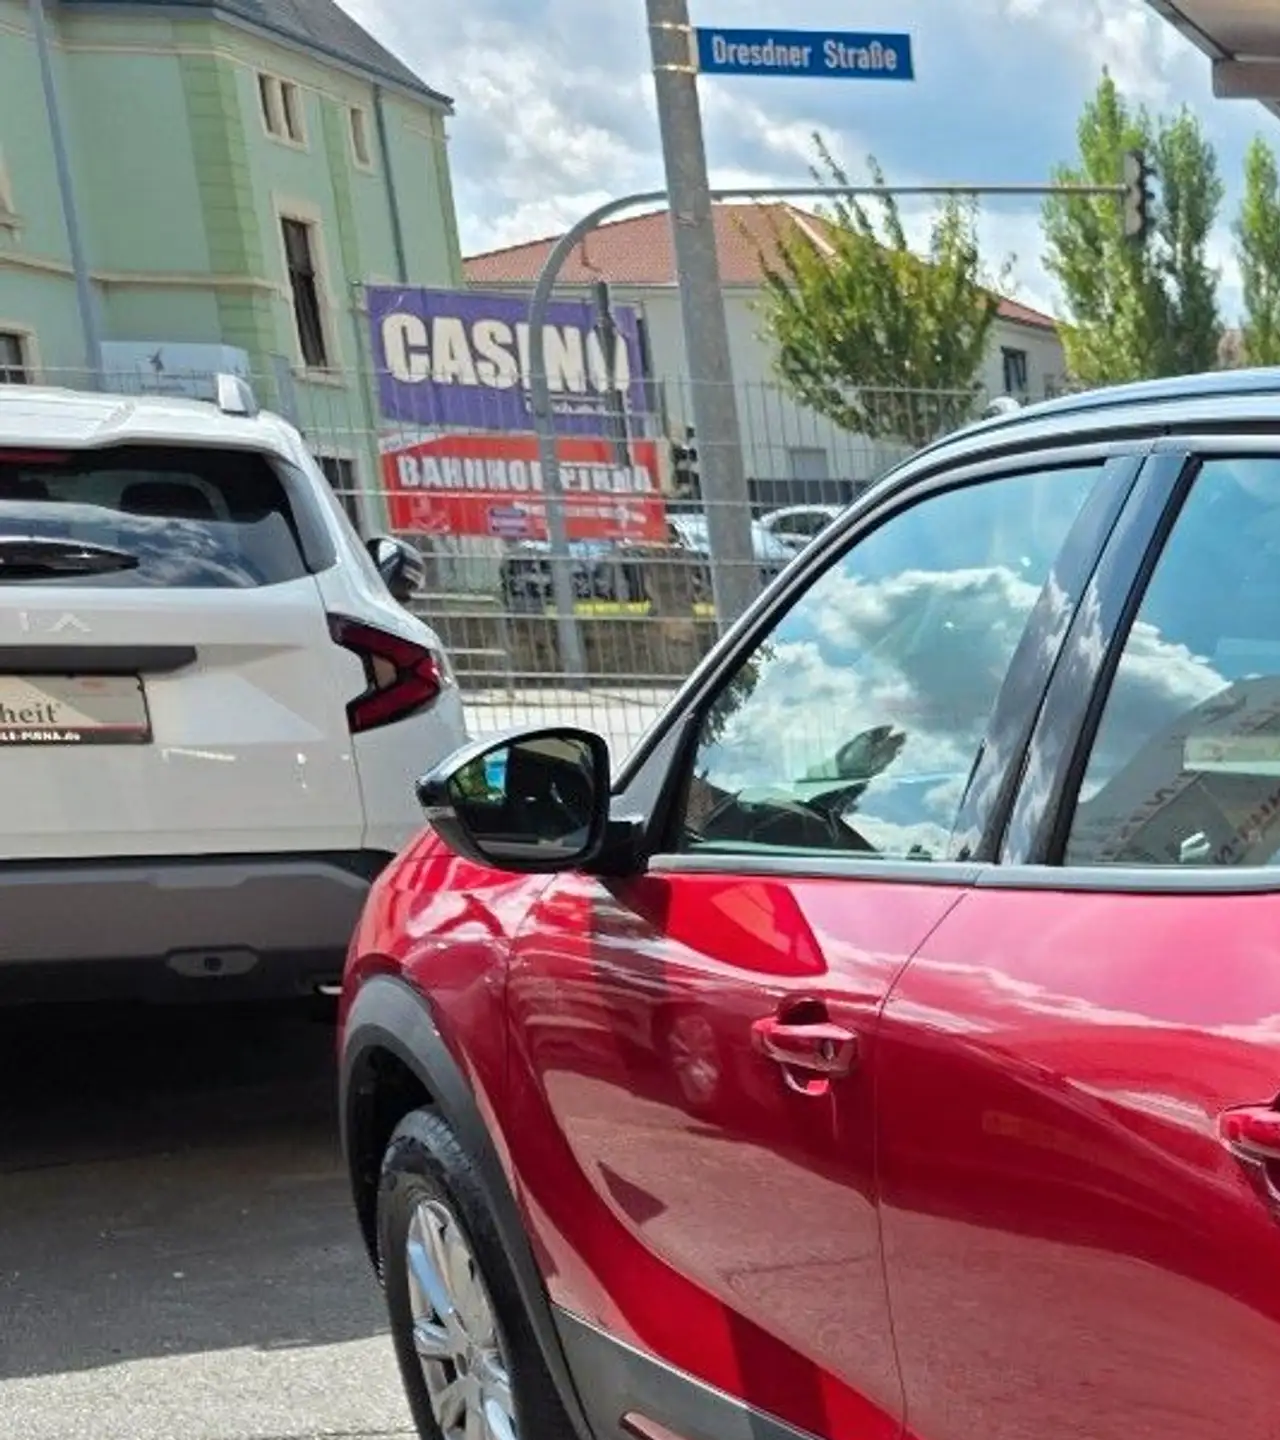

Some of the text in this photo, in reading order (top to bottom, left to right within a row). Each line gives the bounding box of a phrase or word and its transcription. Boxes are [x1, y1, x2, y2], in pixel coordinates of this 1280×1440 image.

[711, 36, 898, 70] Dresdner Straße
[381, 313, 631, 393] CASINO
